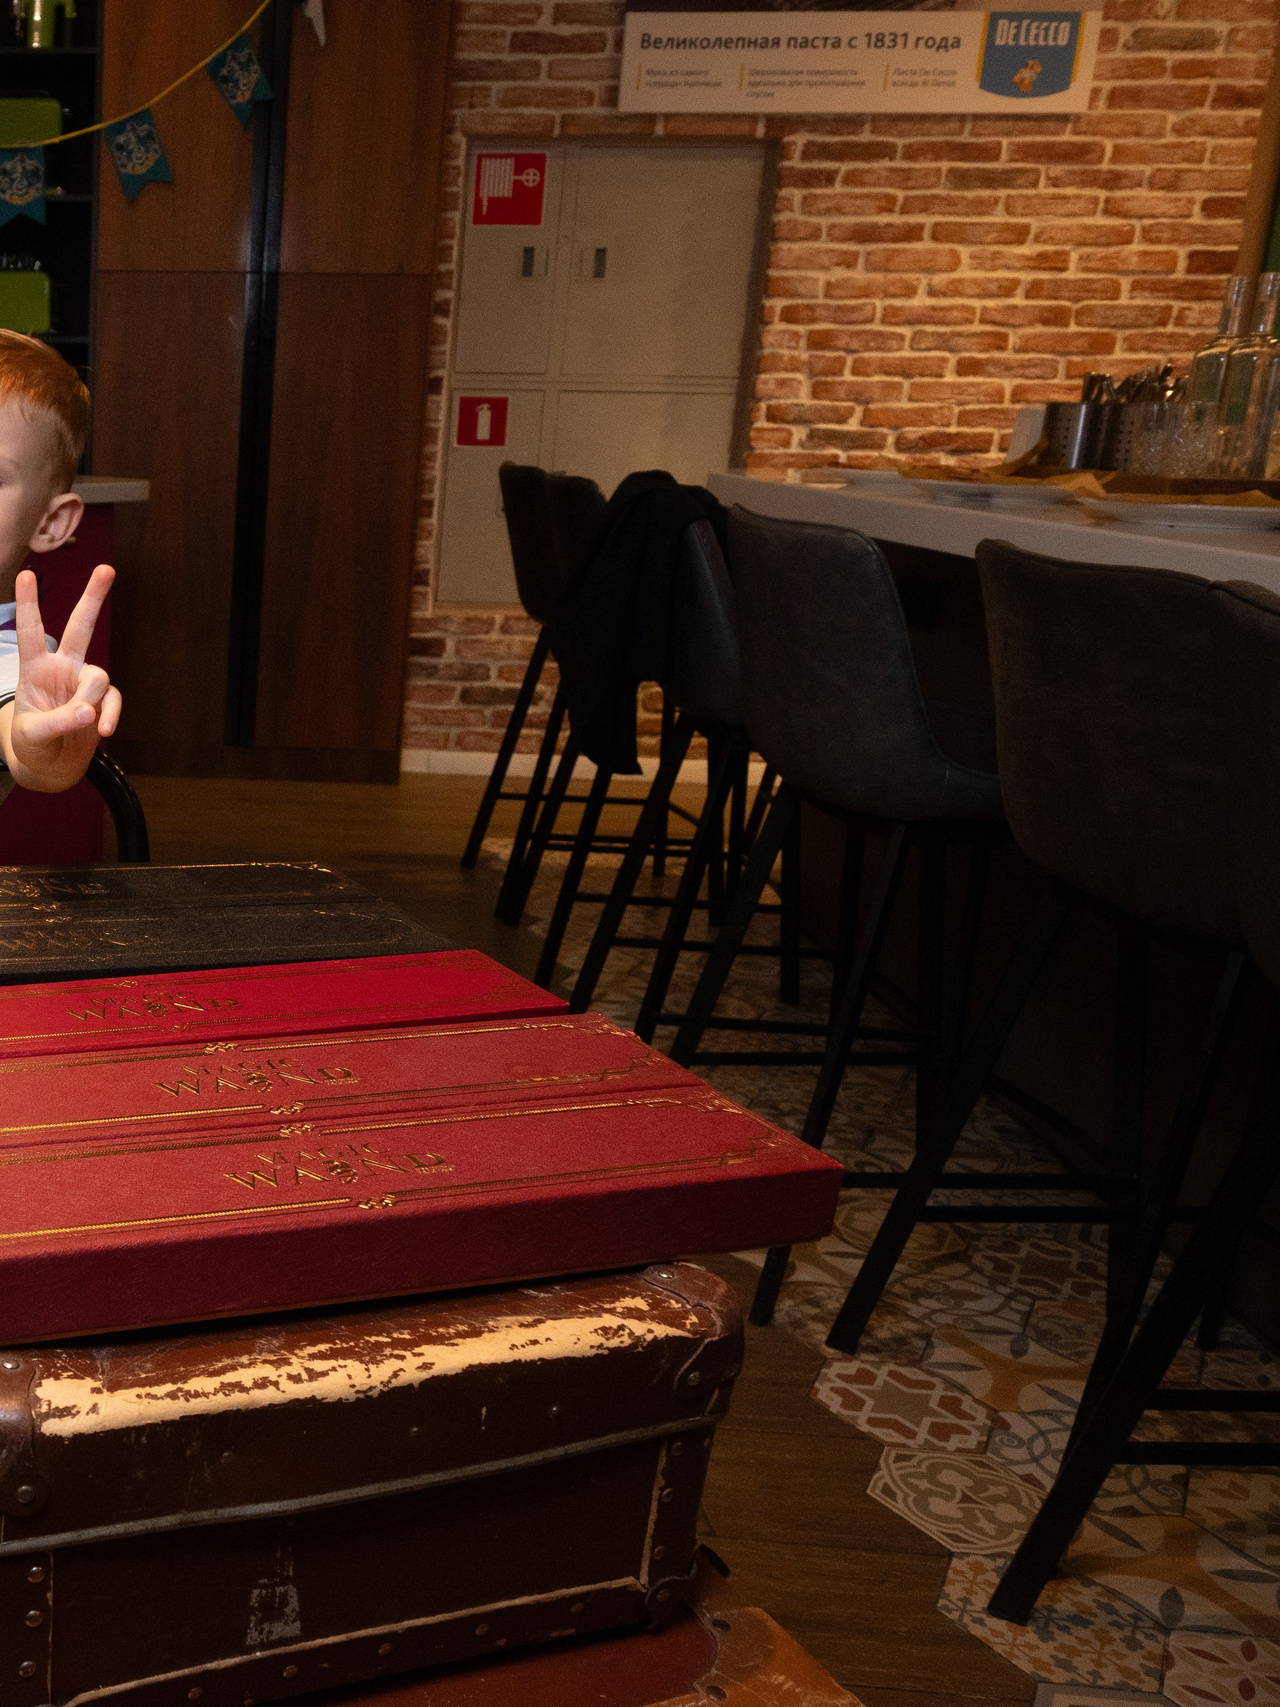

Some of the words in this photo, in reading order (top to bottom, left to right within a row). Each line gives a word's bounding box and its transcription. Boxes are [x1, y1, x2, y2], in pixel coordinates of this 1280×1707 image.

[640, 32, 781, 51] Великолепная
[786, 35, 842, 50] паста
[847, 36, 858, 50] с
[865, 31, 909, 49] 1831
[915, 35, 962, 53] года
[67, 998, 239, 1021] WAND
[182, 1058, 304, 1076] MAGIC
[152, 1067, 354, 1097] WAND
[254, 1143, 387, 1165] MAGIC
[223, 1153, 446, 1190] WAND
